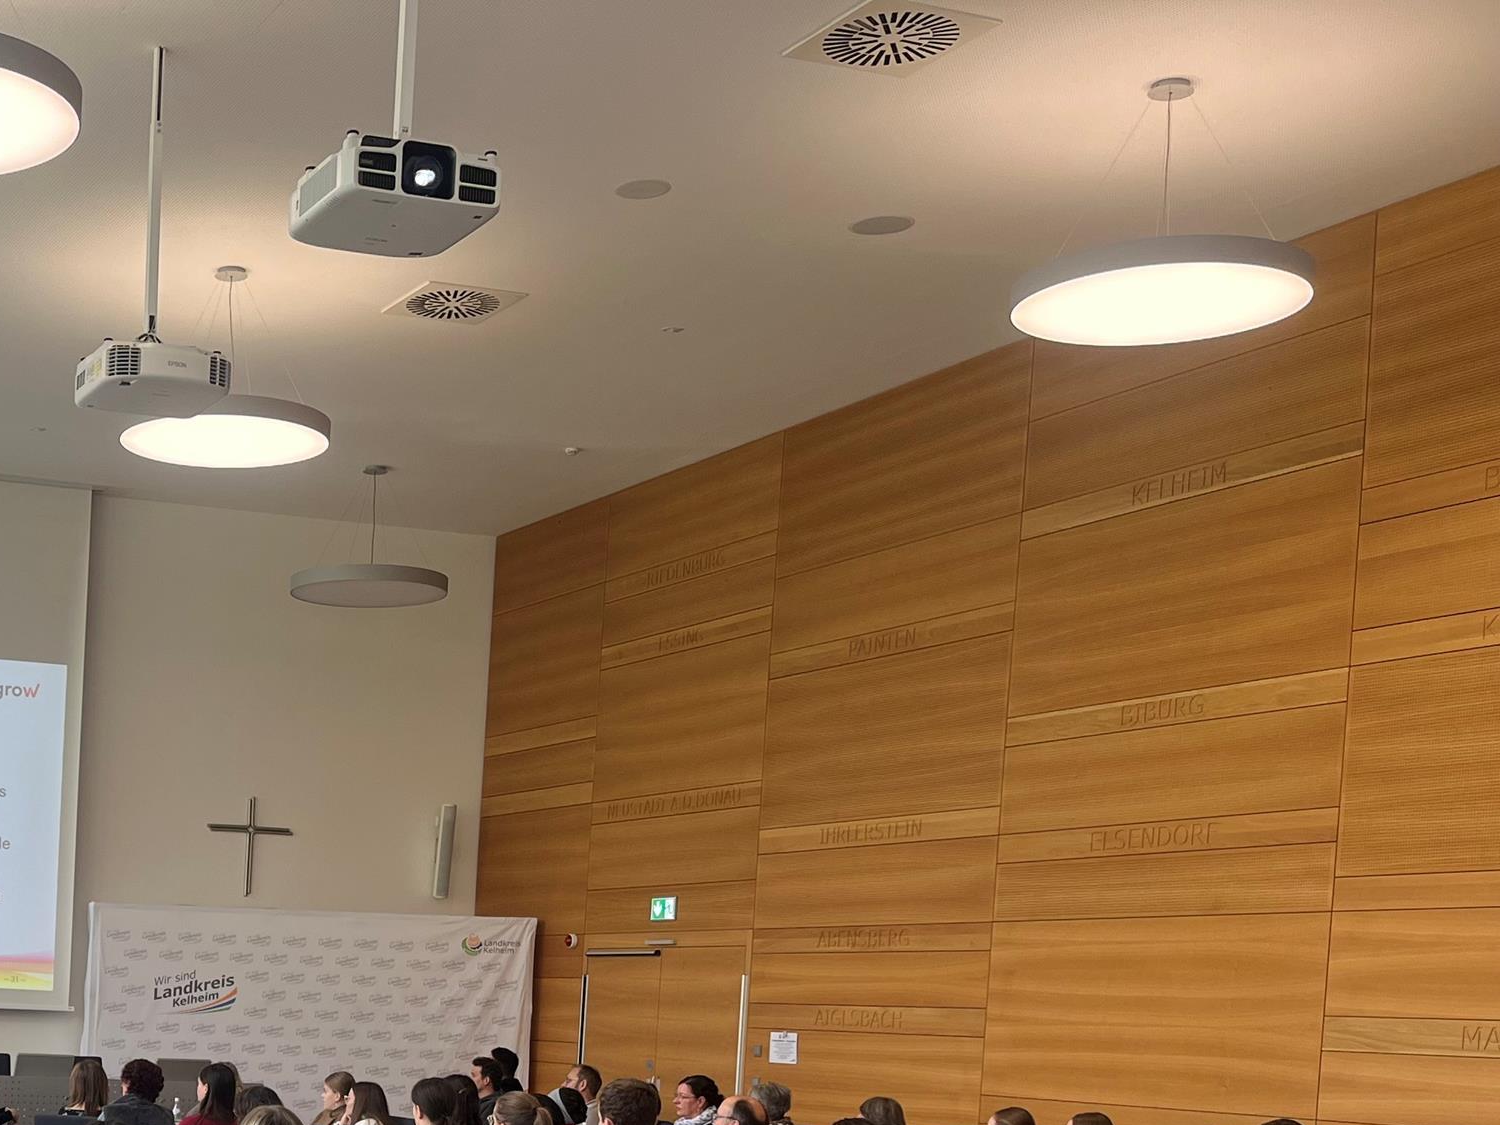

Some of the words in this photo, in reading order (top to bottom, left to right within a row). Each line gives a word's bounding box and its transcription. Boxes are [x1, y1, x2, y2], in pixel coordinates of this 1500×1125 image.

[1131, 461, 1228, 506] KELHEIM
[848, 628, 917, 657] PAINTEN
[1089, 821, 1220, 852] ELSENDORF
[153, 974, 235, 1001] Landkreis
[154, 975, 172, 986] Wir
[175, 969, 197, 982] sind
[172, 992, 219, 1008] Kelheim
[813, 1008, 903, 1029] AIGLSBACH
